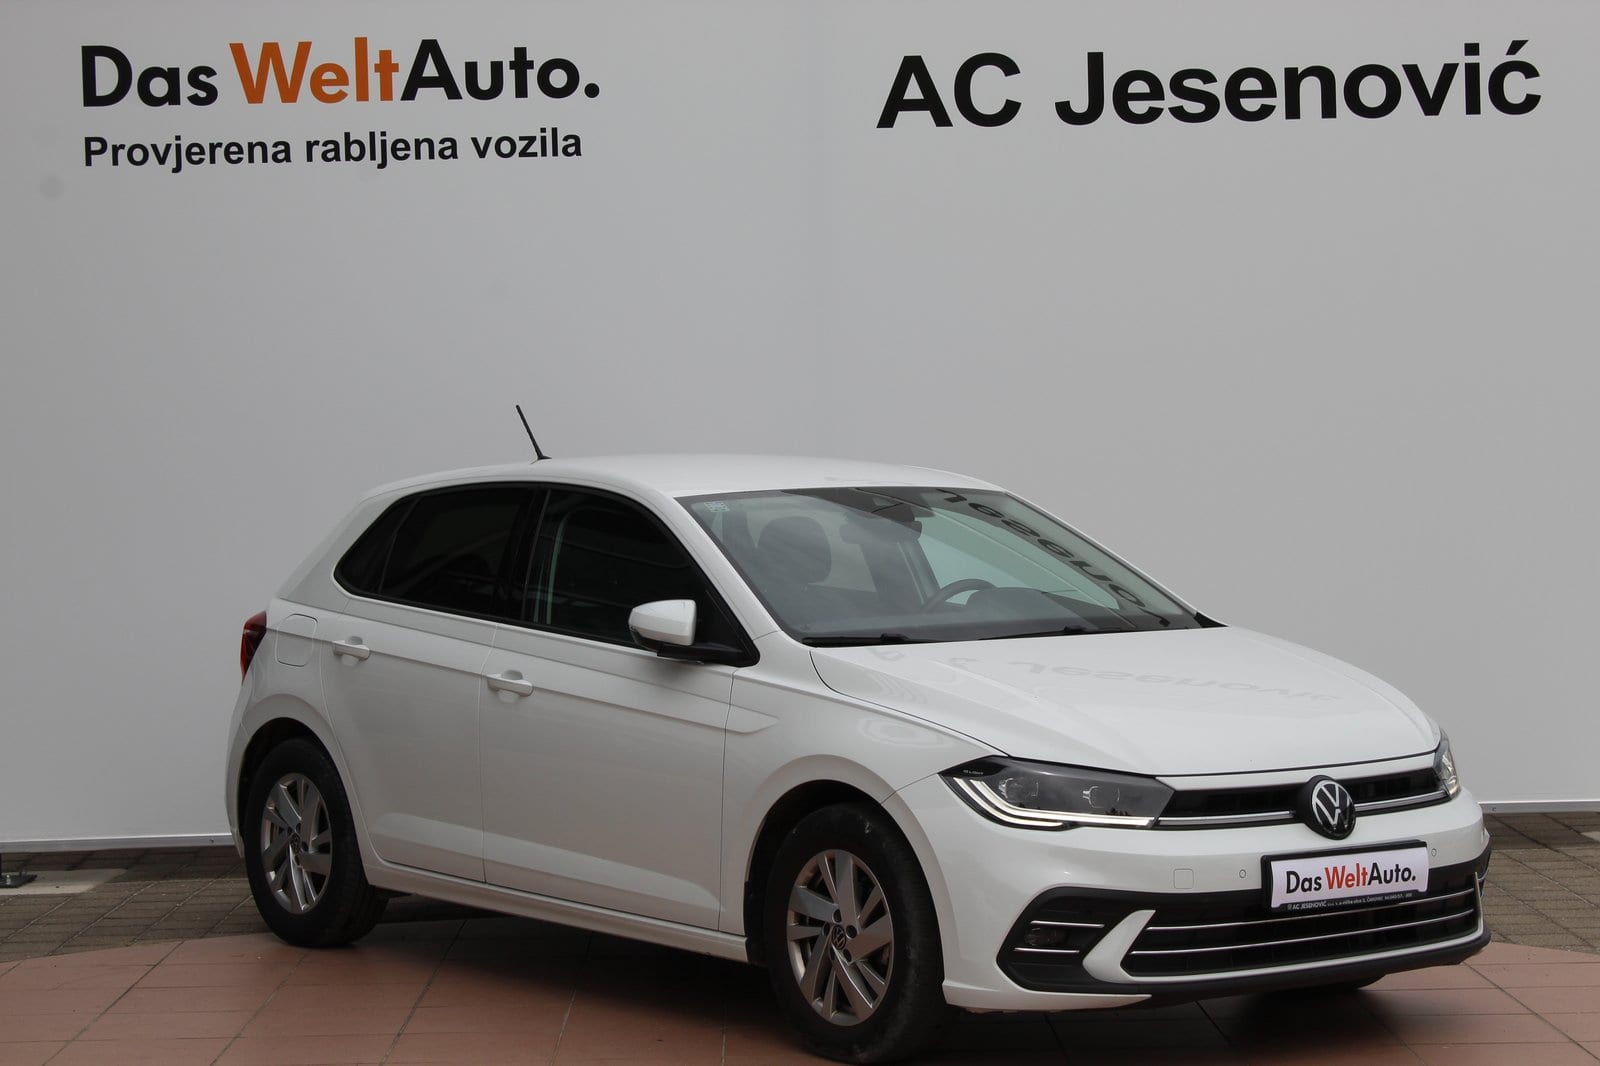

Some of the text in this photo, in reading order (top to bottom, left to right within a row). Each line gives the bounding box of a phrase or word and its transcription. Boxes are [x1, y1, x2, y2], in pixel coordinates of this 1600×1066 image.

[80, 36, 600, 108] Das WeltAuto.
[876, 39, 1542, 129] AC Jesenović
[84, 126, 582, 174] Provjerena rabljena vozila
[1285, 862, 1417, 895] Das WeltAuto.
